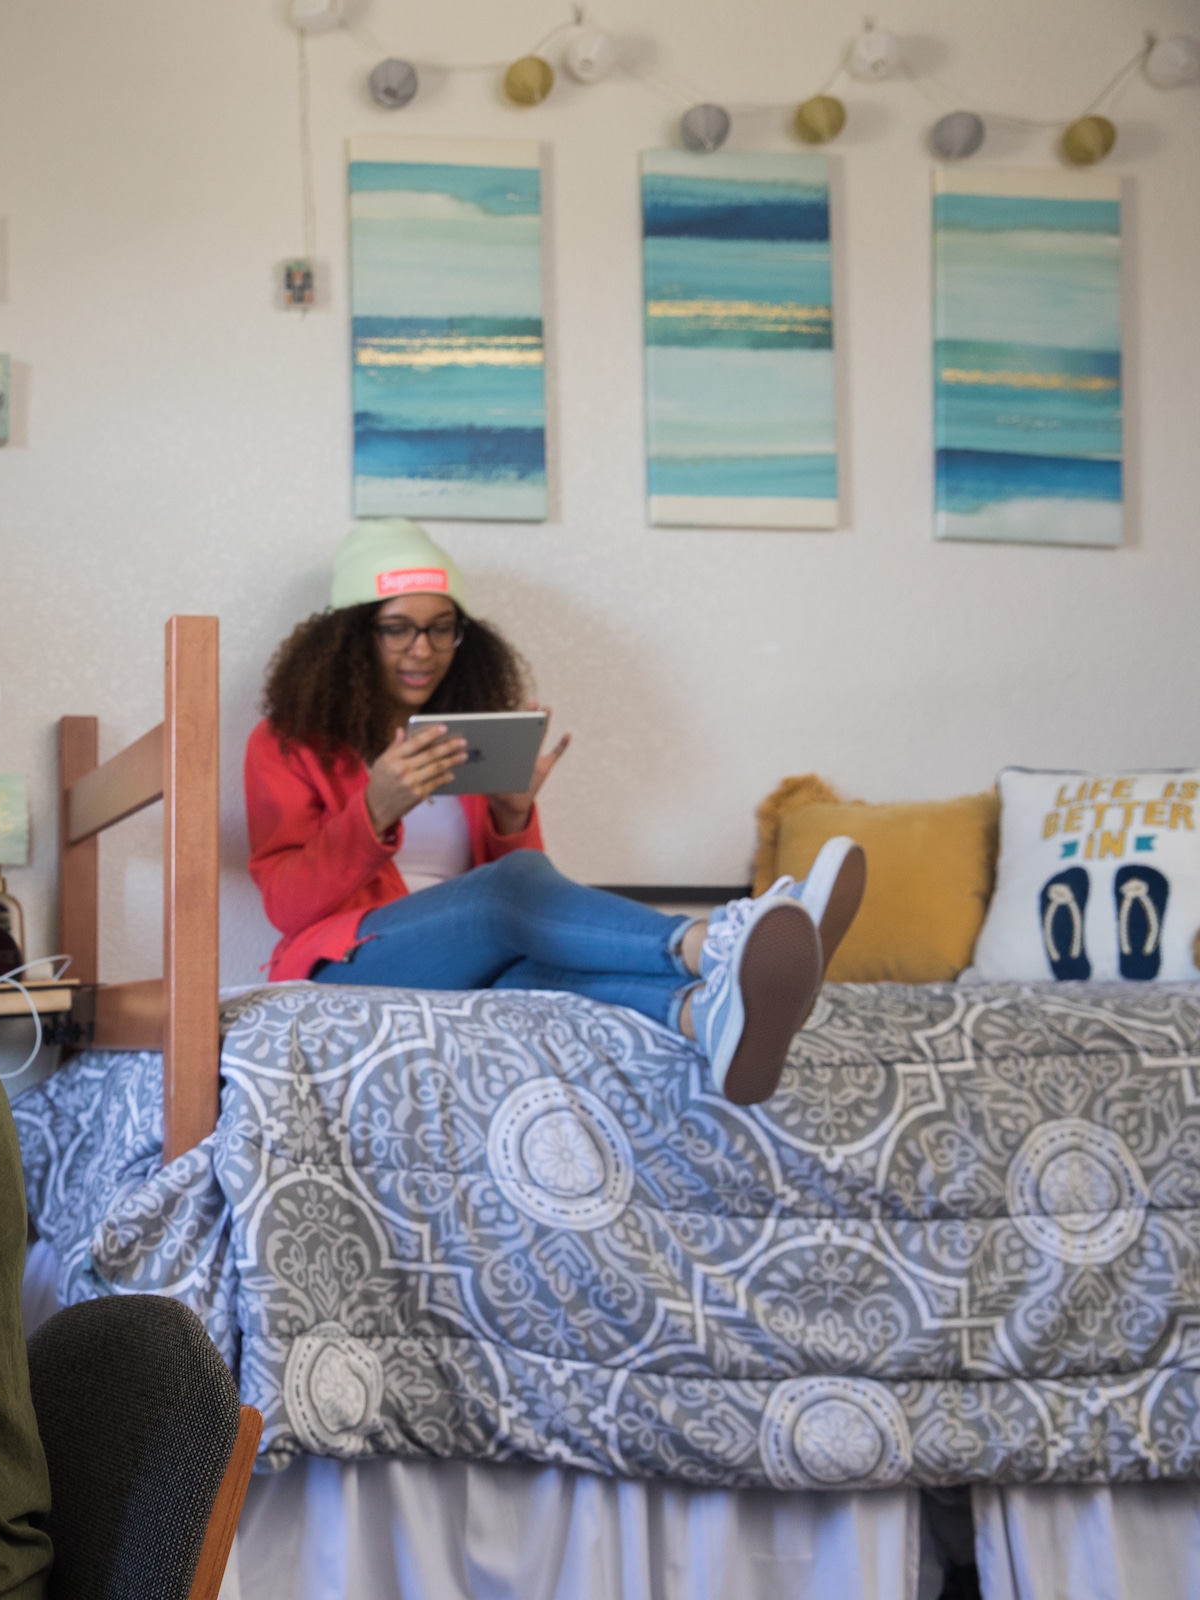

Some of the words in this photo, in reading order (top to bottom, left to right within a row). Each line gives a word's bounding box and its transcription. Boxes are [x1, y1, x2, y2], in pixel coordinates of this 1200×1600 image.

[380, 572, 442, 591] Supreme
[1056, 778, 1136, 807] LIFE
[1163, 780, 1199, 800] IS
[1042, 801, 1195, 840] BETTER
[1084, 829, 1126, 860] IN
